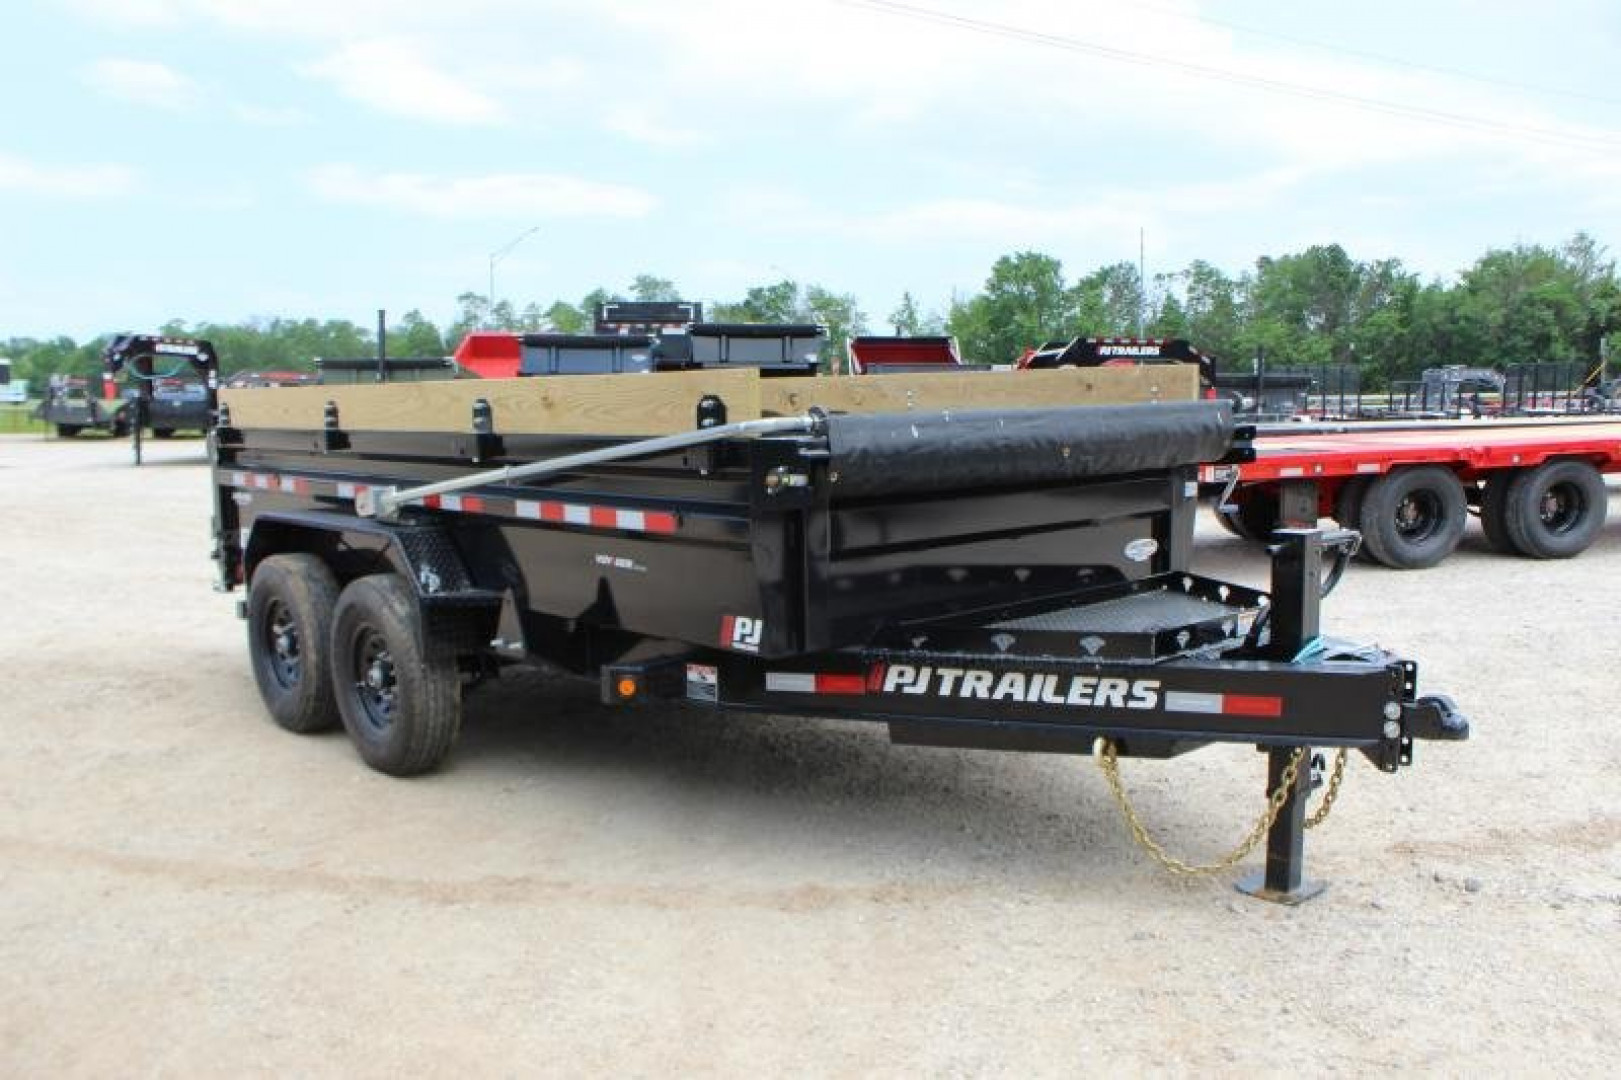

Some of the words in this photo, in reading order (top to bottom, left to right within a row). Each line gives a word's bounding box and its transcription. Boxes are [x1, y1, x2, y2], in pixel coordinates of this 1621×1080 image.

[733, 616, 762, 643] PJ
[882, 664, 931, 694] PJ
[935, 669, 1161, 710] TRAILERS
